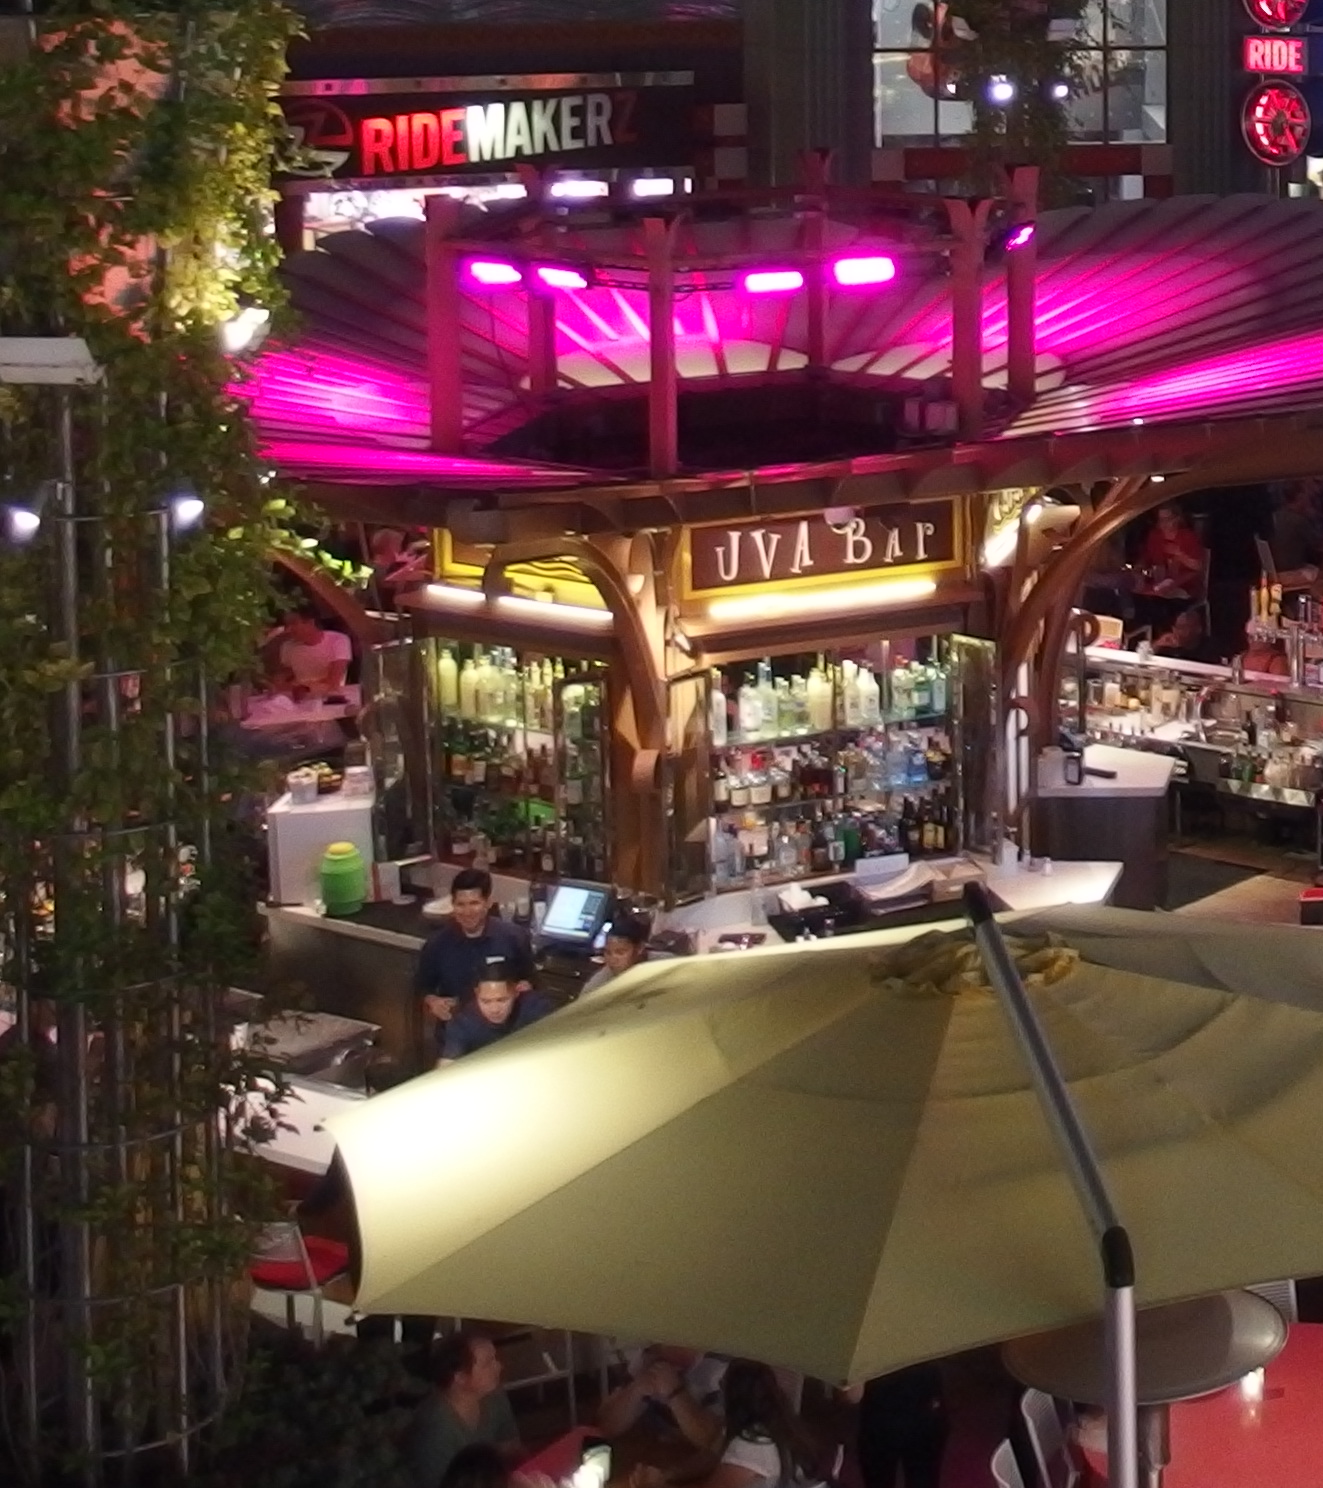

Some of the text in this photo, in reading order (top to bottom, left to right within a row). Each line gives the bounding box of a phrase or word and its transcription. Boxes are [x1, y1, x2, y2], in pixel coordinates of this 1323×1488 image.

[1247, 38, 1304, 71] RIDE
[361, 91, 639, 175] RIDEMAKERZ
[714, 520, 815, 581] UVA
